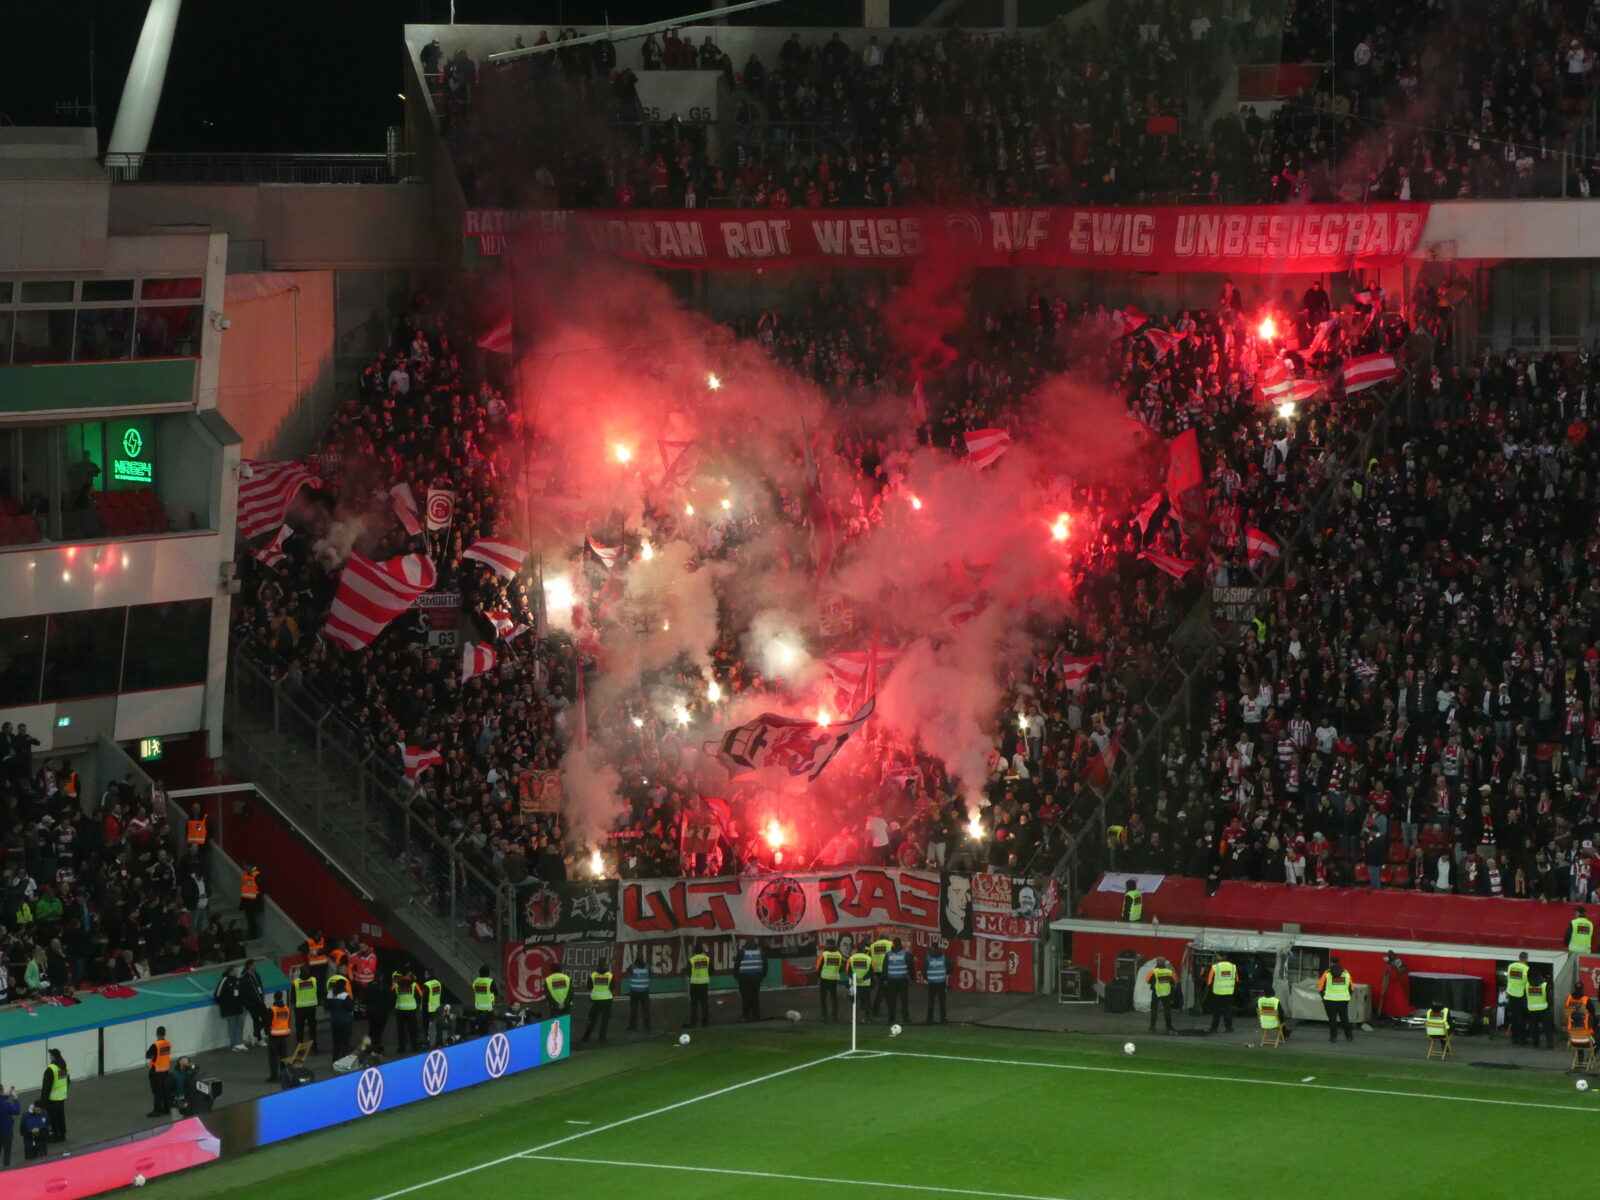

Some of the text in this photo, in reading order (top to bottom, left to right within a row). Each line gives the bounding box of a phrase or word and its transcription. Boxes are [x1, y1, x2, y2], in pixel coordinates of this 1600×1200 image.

[689, 107, 711, 120] G5
[720, 219, 790, 258] ROT
[811, 217, 923, 257] WEISS
[990, 210, 1052, 253] AUF
[1068, 212, 1155, 257] EWIG
[1174, 212, 1424, 258] UNBESIEGBAR
[438, 632, 455, 646] G3
